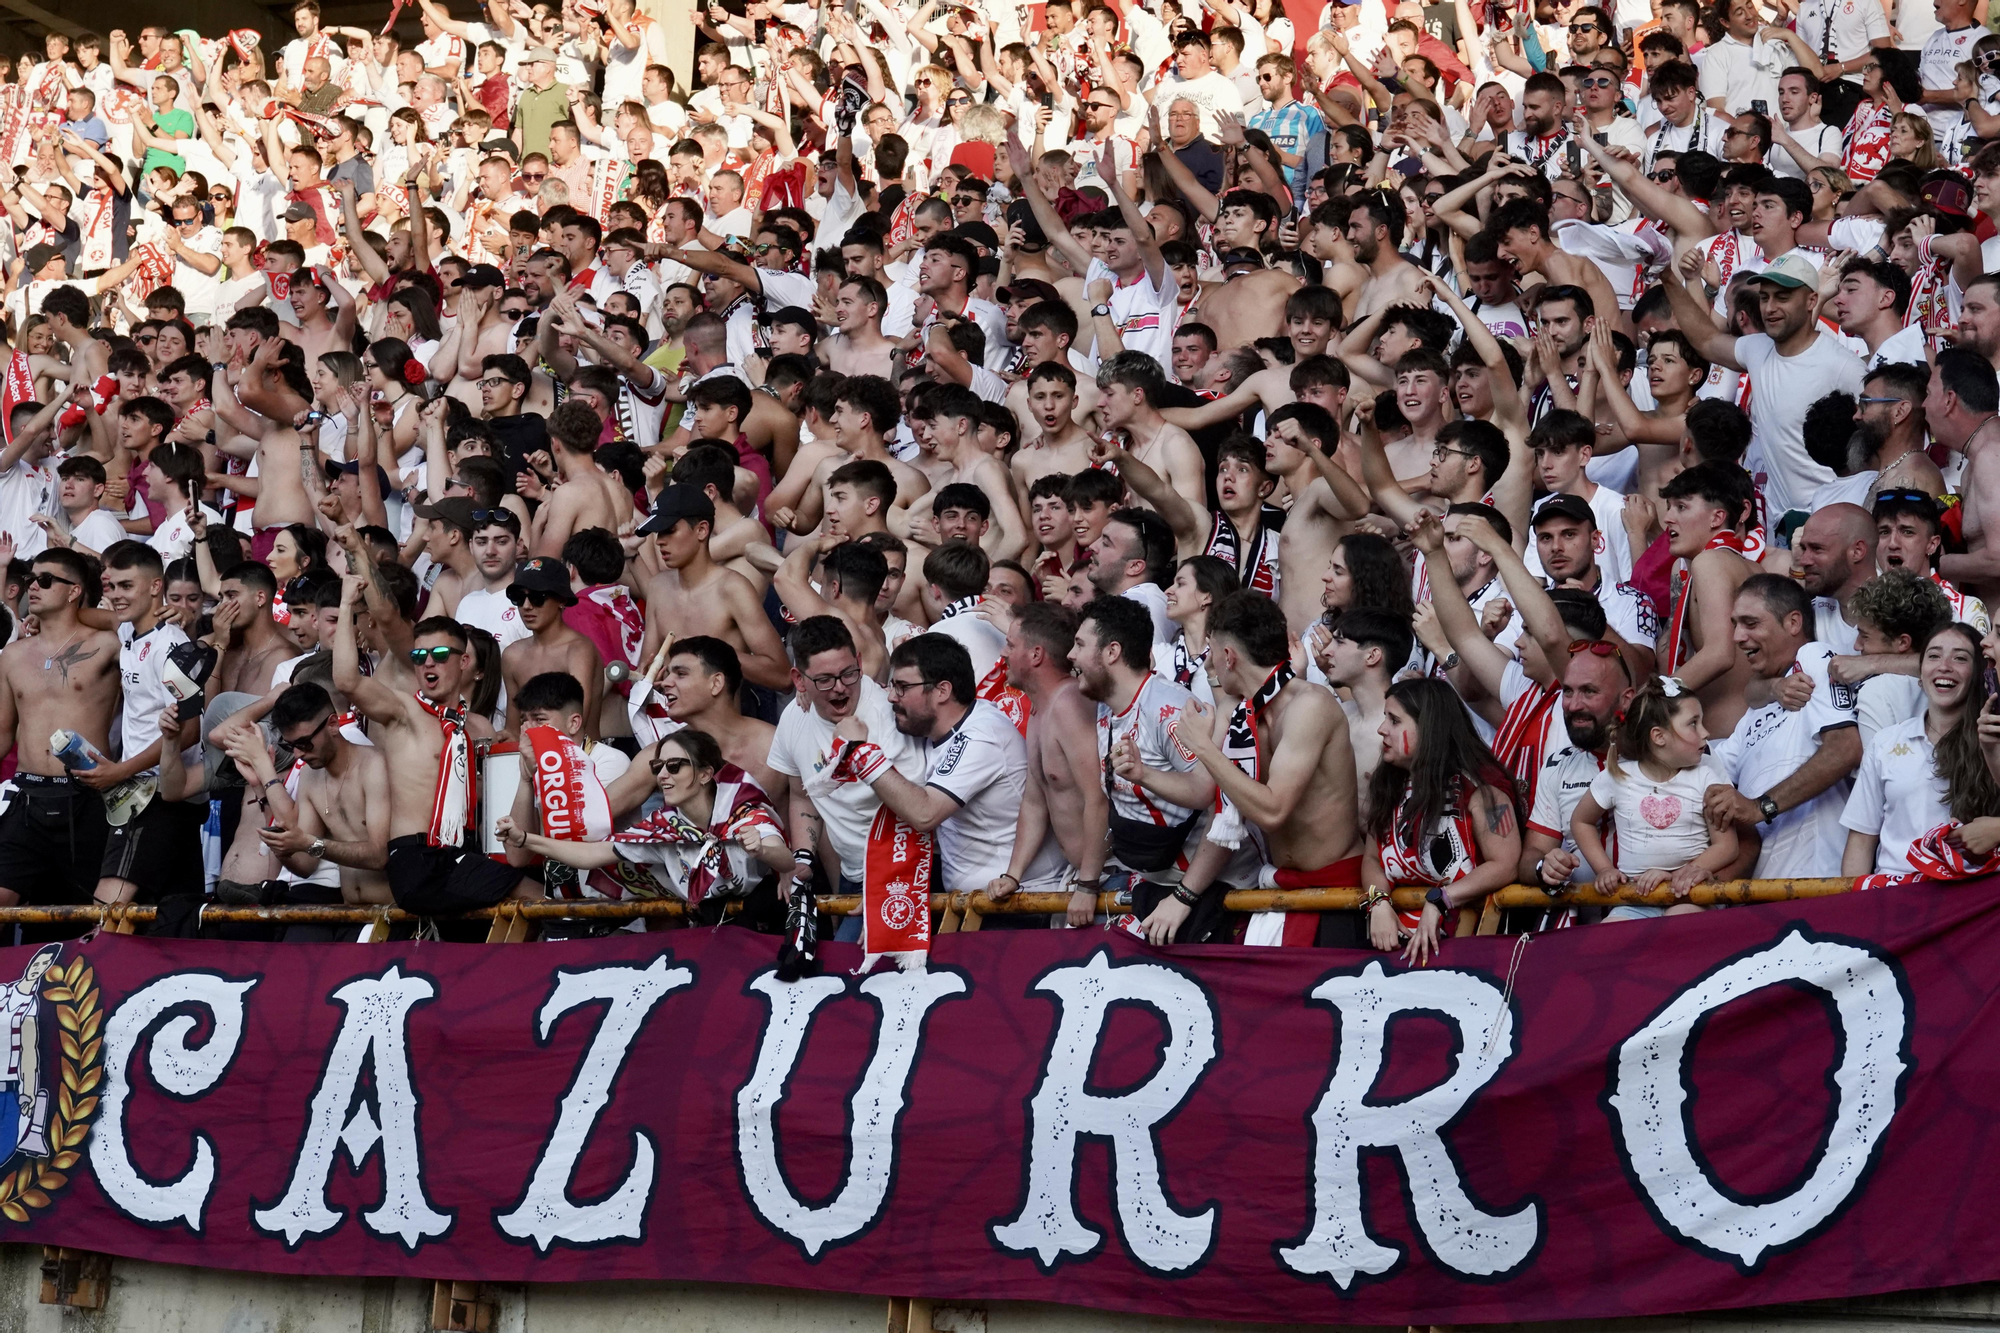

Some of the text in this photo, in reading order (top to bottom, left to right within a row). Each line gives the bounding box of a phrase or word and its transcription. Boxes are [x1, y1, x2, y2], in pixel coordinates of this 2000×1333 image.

[540, 750, 573, 841] ORGUL
[1562, 779, 1593, 789] humme
[89, 929, 1908, 1290] CAZURRO
